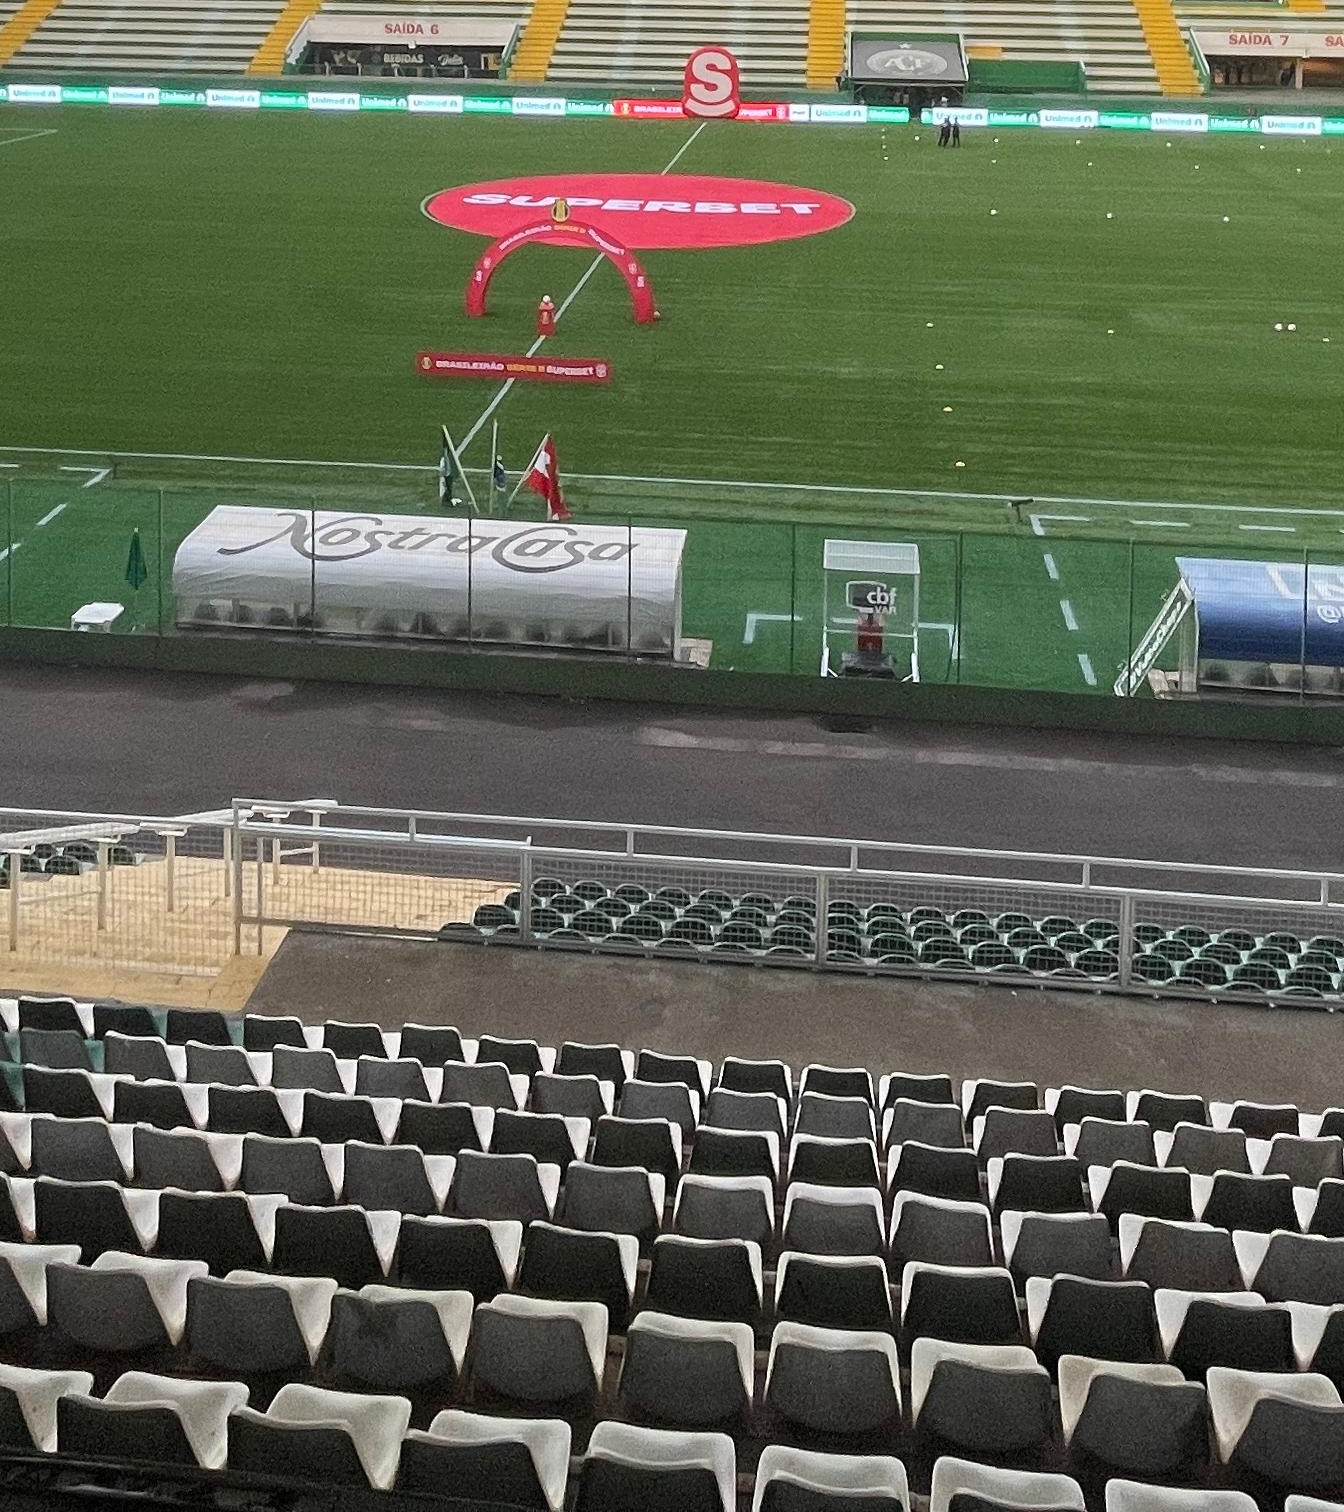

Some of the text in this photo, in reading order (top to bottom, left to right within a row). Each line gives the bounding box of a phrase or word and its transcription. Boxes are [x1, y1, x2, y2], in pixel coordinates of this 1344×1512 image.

[385, 22, 439, 34] SAÍDA 6
[1229, 31, 1289, 46] SAÍDA 7
[383, 53, 424, 64] BEBIDAS
[462, 193, 820, 215] SUPERBET
[867, 586, 896, 605] cbf
